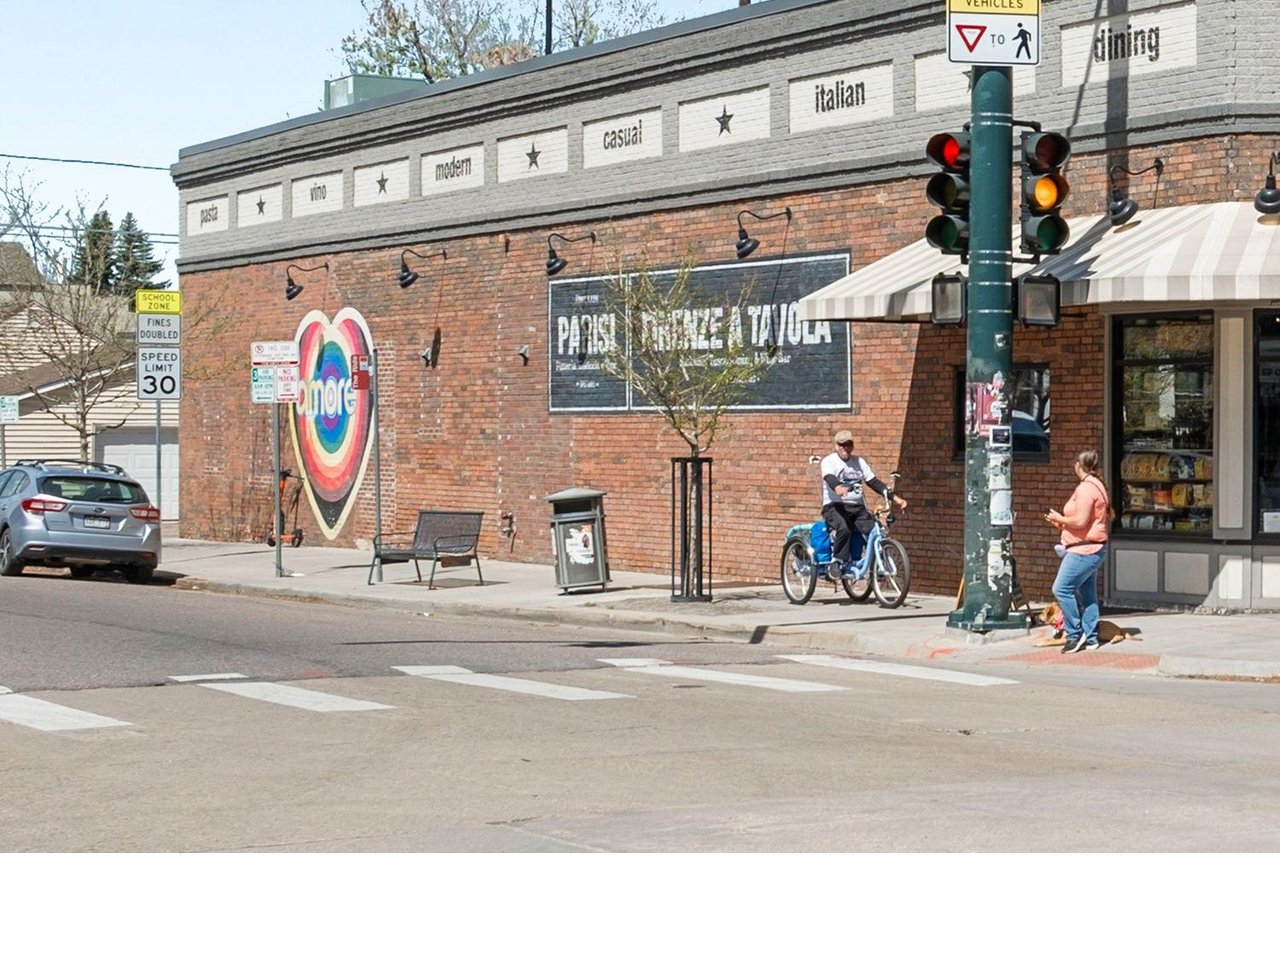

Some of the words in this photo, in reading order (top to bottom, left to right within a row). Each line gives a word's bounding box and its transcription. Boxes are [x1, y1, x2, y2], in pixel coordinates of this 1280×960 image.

[990, 34, 1006, 45] TO
[1094, 24, 1160, 62] dining
[815, 80, 866, 113] italian
[603, 119, 643, 150] casual
[435, 156, 472, 181] modern
[310, 182, 327, 202] vino
[200, 204, 218, 229] pasta
[142, 293, 176, 302] SCHOOL
[147, 302, 170, 310] ZONE
[147, 318, 171, 327] FINES
[140, 330, 178, 339] DOUBLED
[558, 312, 616, 355] PARISI
[141, 352, 178, 362] SPEED
[145, 364, 173, 372] LIMIT
[142, 375, 176, 394] 30
[297, 375, 357, 418] amore
